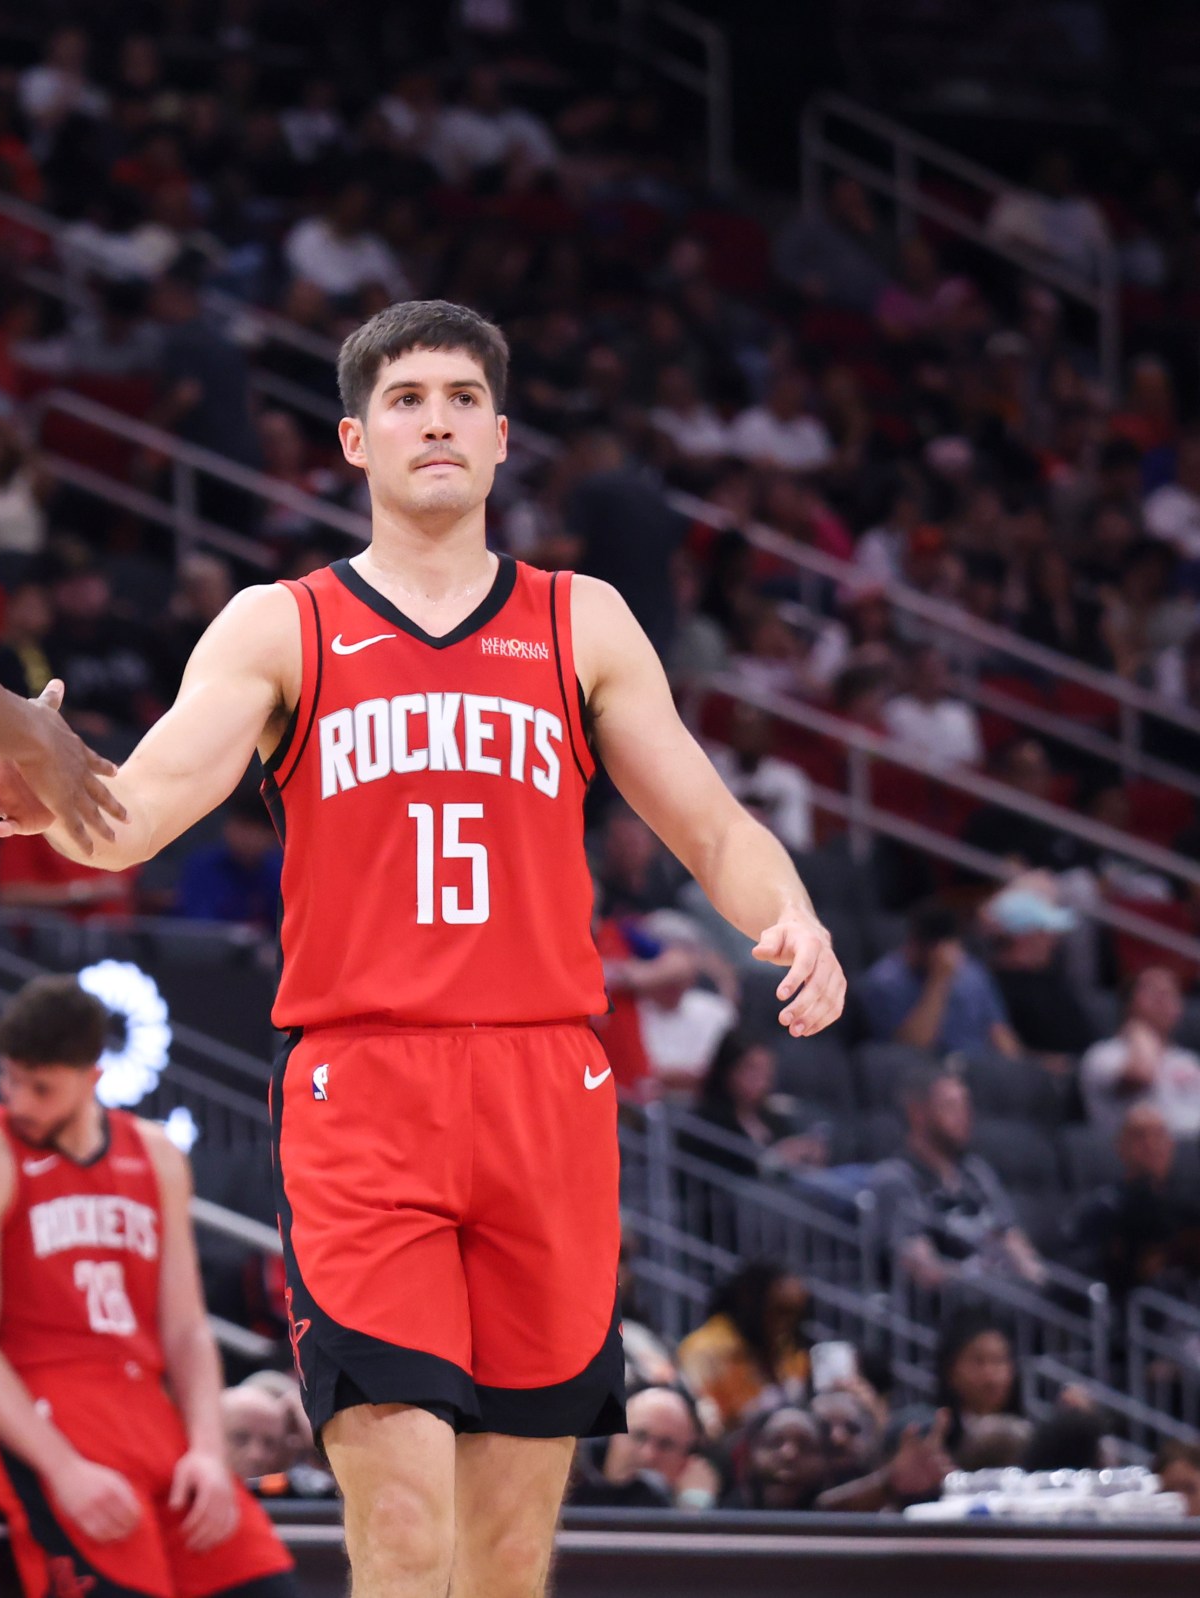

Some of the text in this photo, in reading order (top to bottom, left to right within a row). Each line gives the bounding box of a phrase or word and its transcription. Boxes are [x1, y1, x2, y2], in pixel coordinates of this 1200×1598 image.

[481, 637, 547, 652] MEMORIAL
[481, 645, 549, 660] HERMANN
[318, 692, 563, 800] ROCKETS
[408, 803, 490, 924] 15
[29, 1194, 158, 1259] ROCKETS
